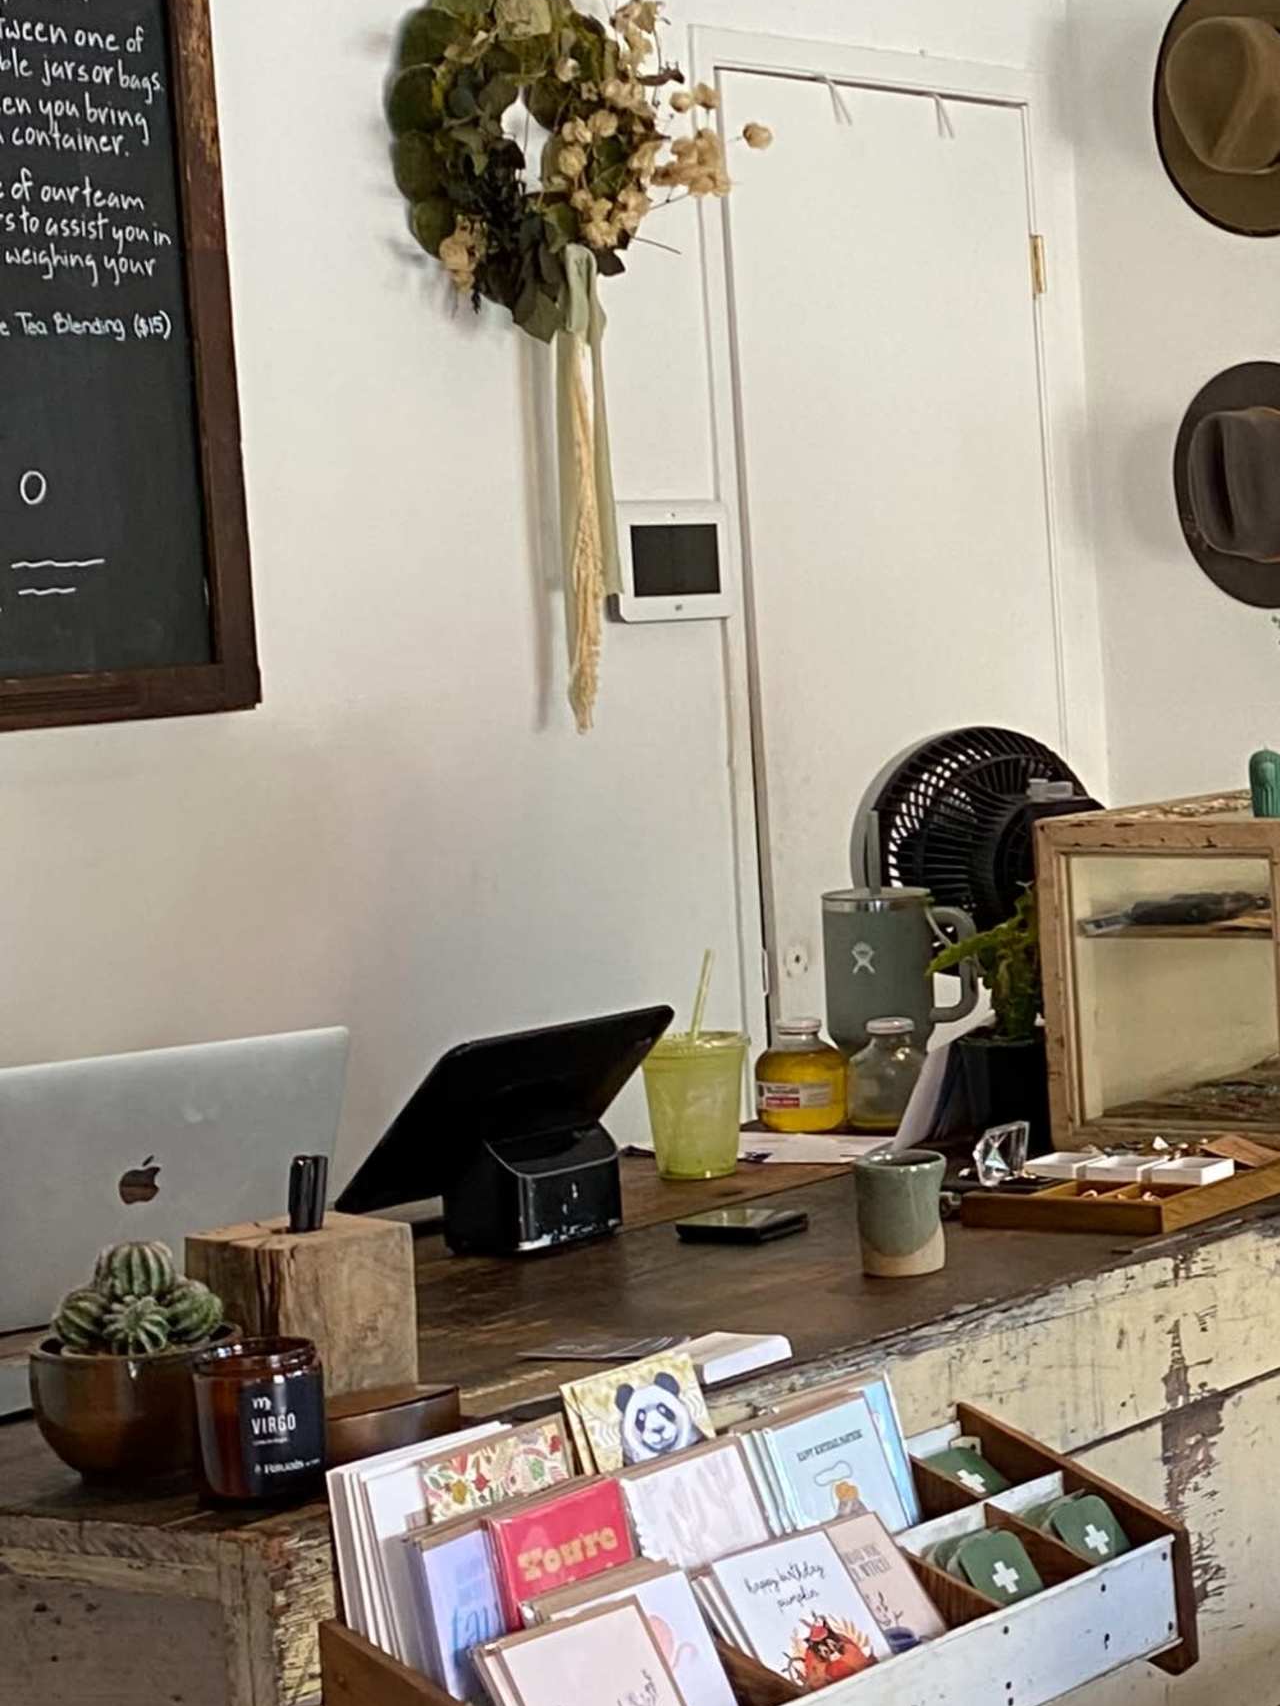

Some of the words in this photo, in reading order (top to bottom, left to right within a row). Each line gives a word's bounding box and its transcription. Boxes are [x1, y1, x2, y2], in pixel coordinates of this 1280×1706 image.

[74, 28, 120, 52] one
[126, 25, 145, 53] of
[41, 54, 89, 88] jars
[92, 64, 114, 86] or
[39, 98, 80, 136] you
[84, 91, 150, 146] bring
[12, 120, 131, 157] container.
[11, 167, 34, 202] of
[41, 184, 80, 204] our
[82, 175, 145, 210] team
[20, 205, 40, 234] to
[45, 212, 110, 240] assist
[112, 225, 149, 255] you
[152, 222, 172, 246] in
[5, 242, 99, 288] weighing
[103, 255, 157, 286] your
[14, 311, 49, 336] Tea
[53, 311, 126, 342] Blending
[133, 309, 173, 340] ($15)
[251, 1413, 297, 1435] VIRGO
